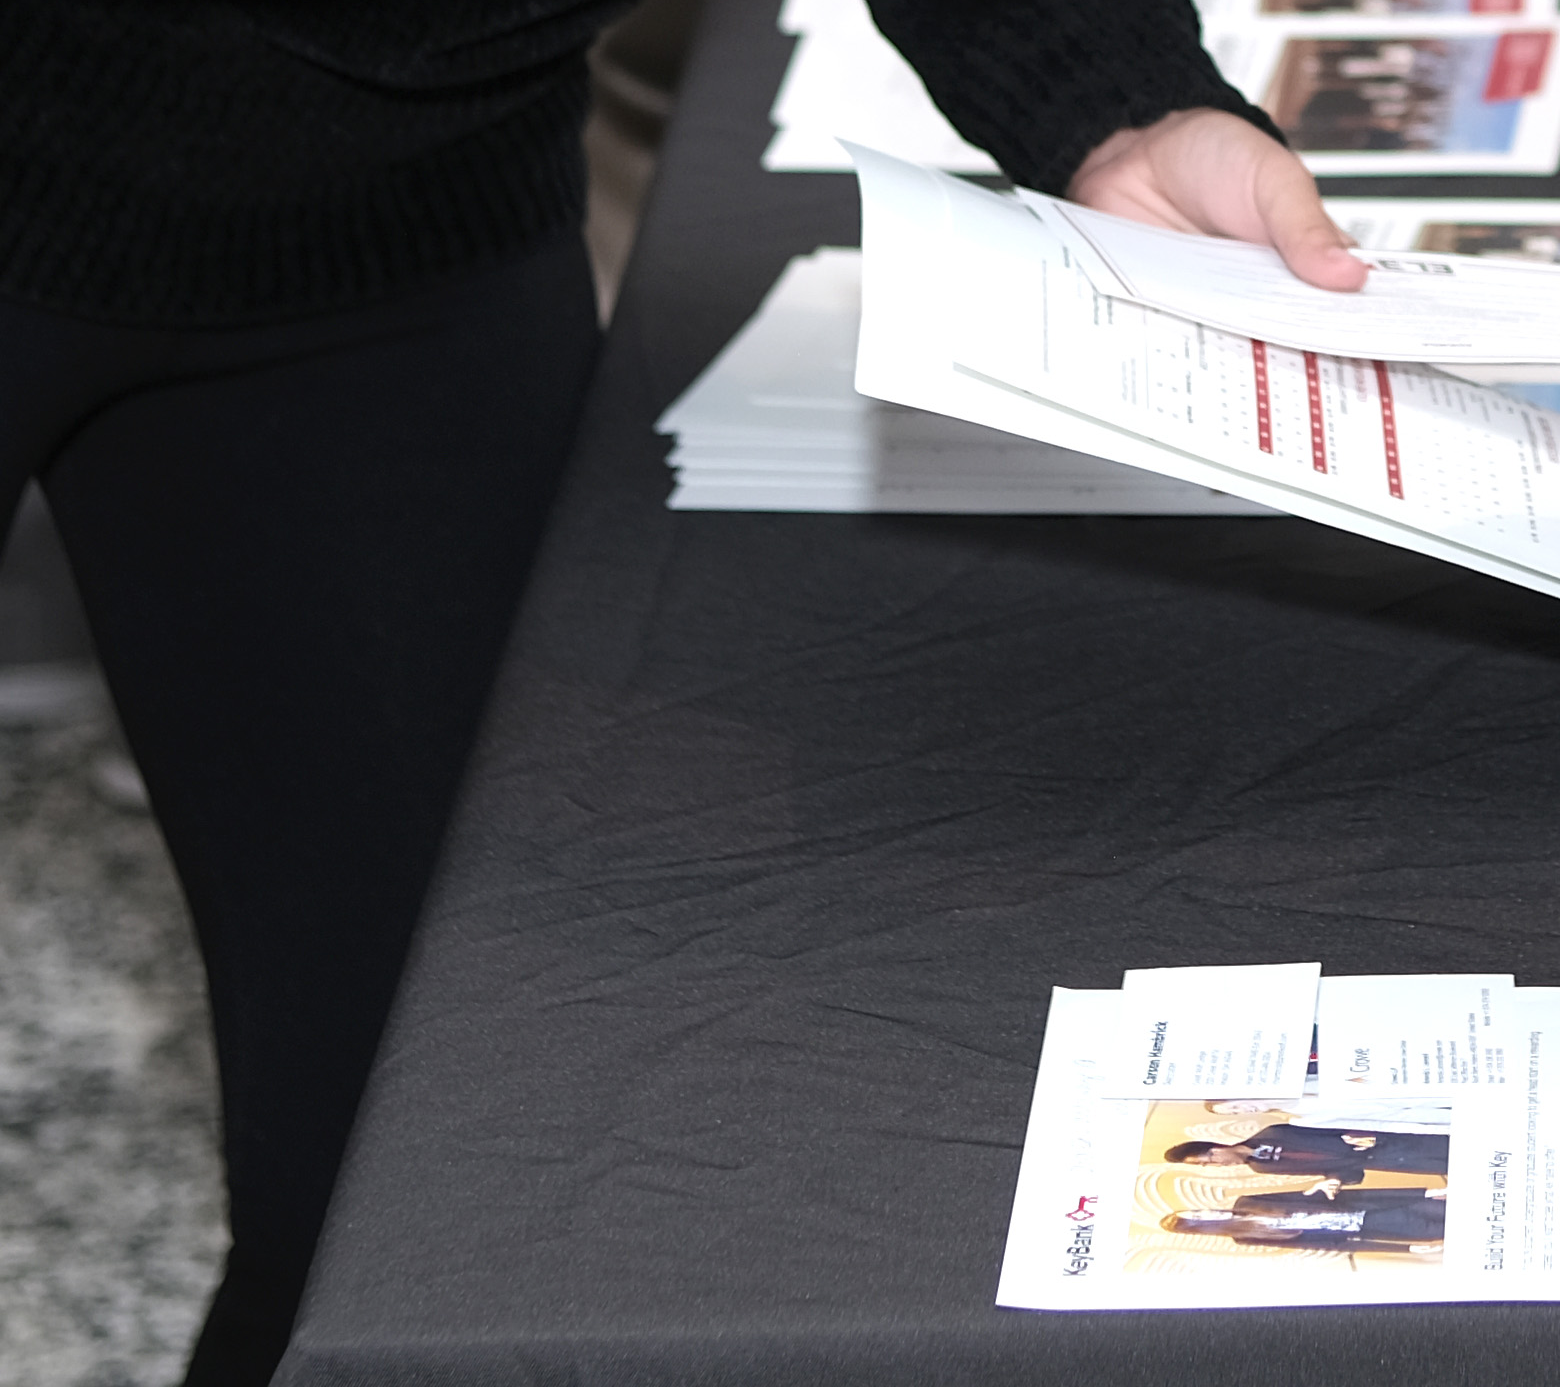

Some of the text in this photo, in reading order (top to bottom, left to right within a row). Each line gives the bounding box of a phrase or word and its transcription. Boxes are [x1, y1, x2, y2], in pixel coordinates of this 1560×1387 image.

[1349, 1048, 1370, 1072] Crowe
[1484, 1151, 1512, 1270] Build Your Future with Key
[1062, 1224, 1094, 1277] KeyBank
